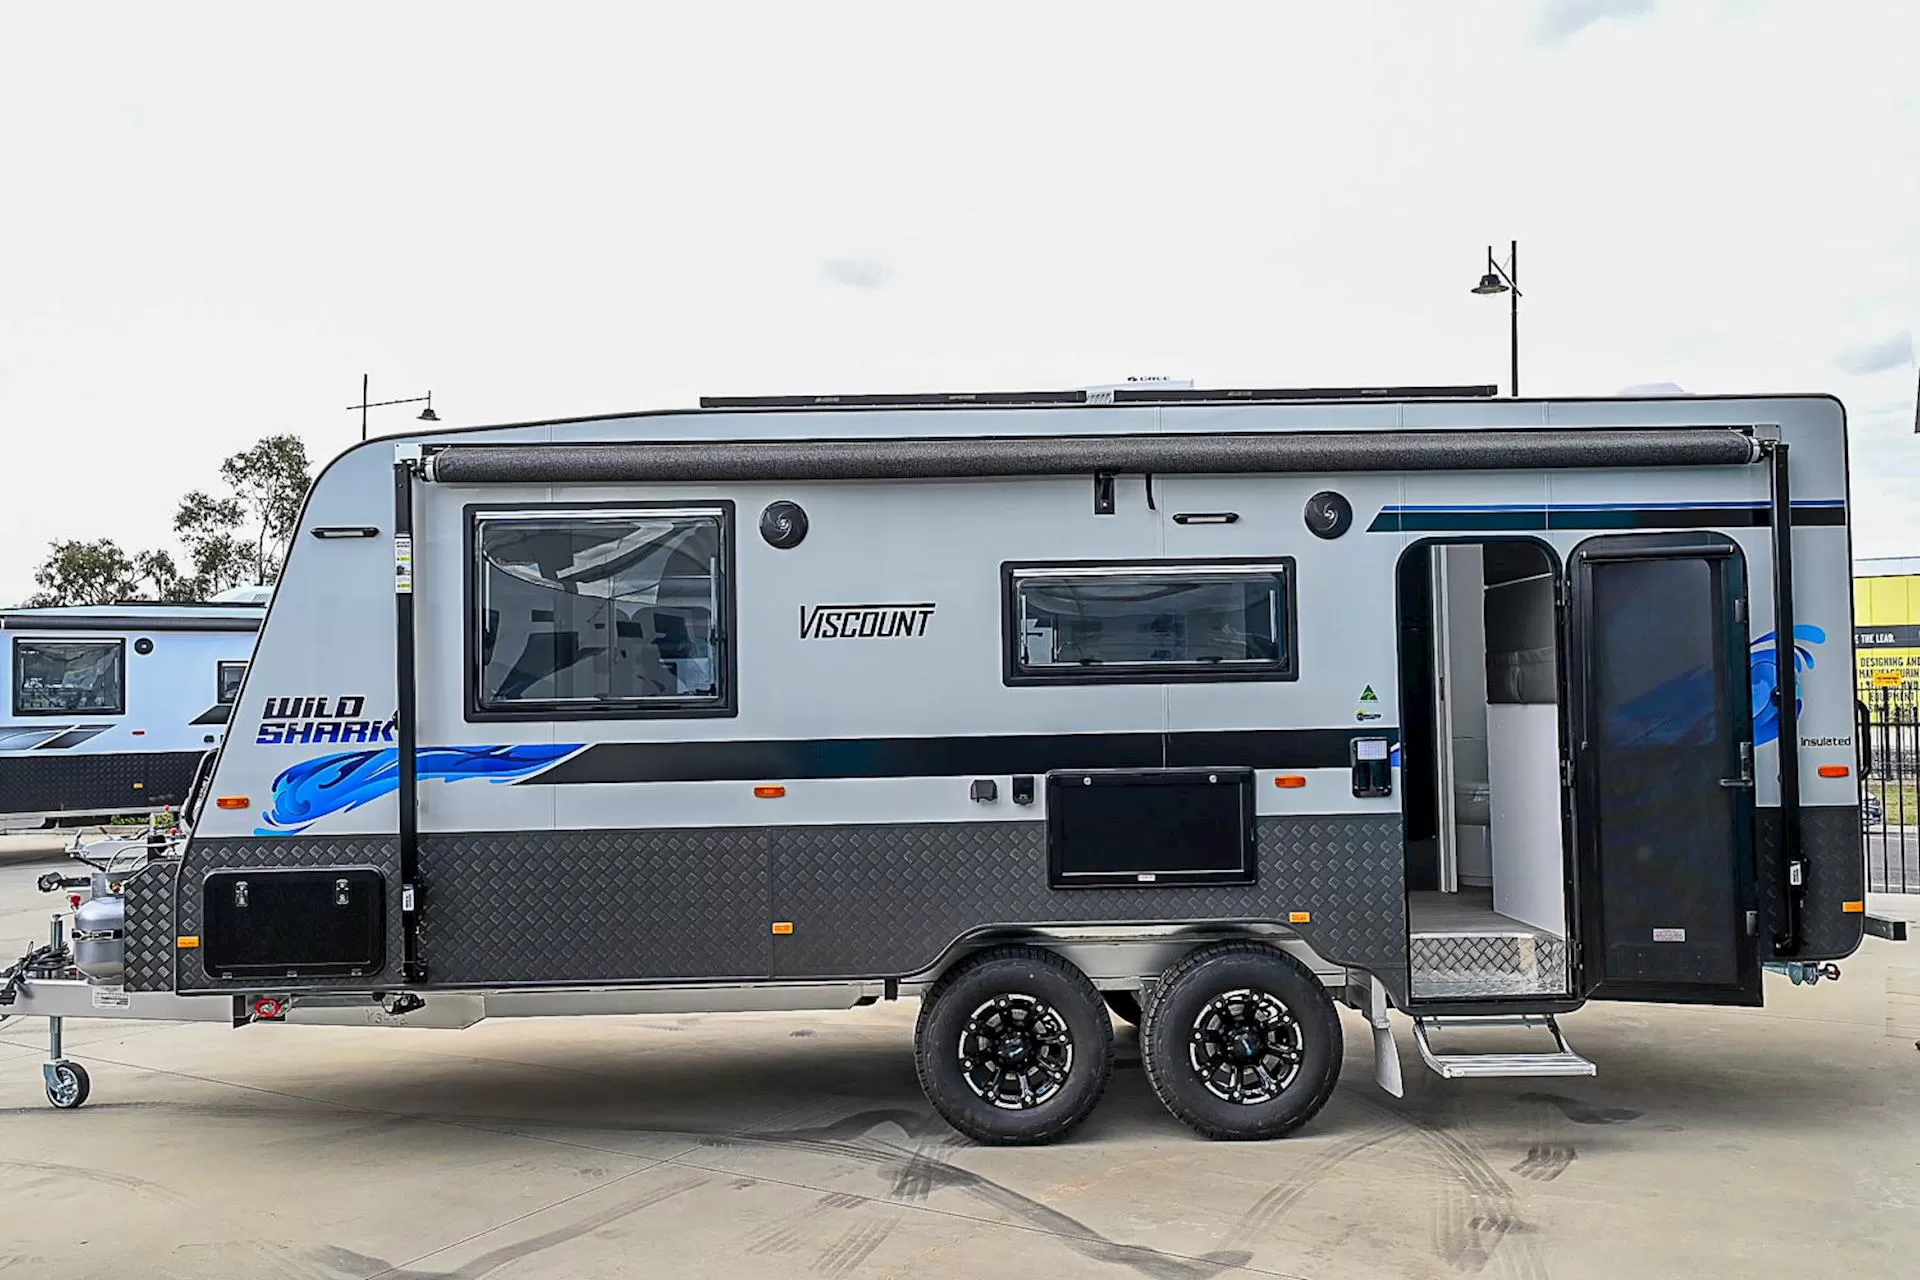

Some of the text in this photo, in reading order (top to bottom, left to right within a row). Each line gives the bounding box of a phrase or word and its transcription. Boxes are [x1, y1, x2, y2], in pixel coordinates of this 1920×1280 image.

[800, 603, 936, 639] VISCOUNT
[1861, 634, 1874, 643] THE
[1861, 657, 1903, 667] DESIGNING
[262, 696, 366, 720] WILD
[255, 720, 397, 744] SHARK
